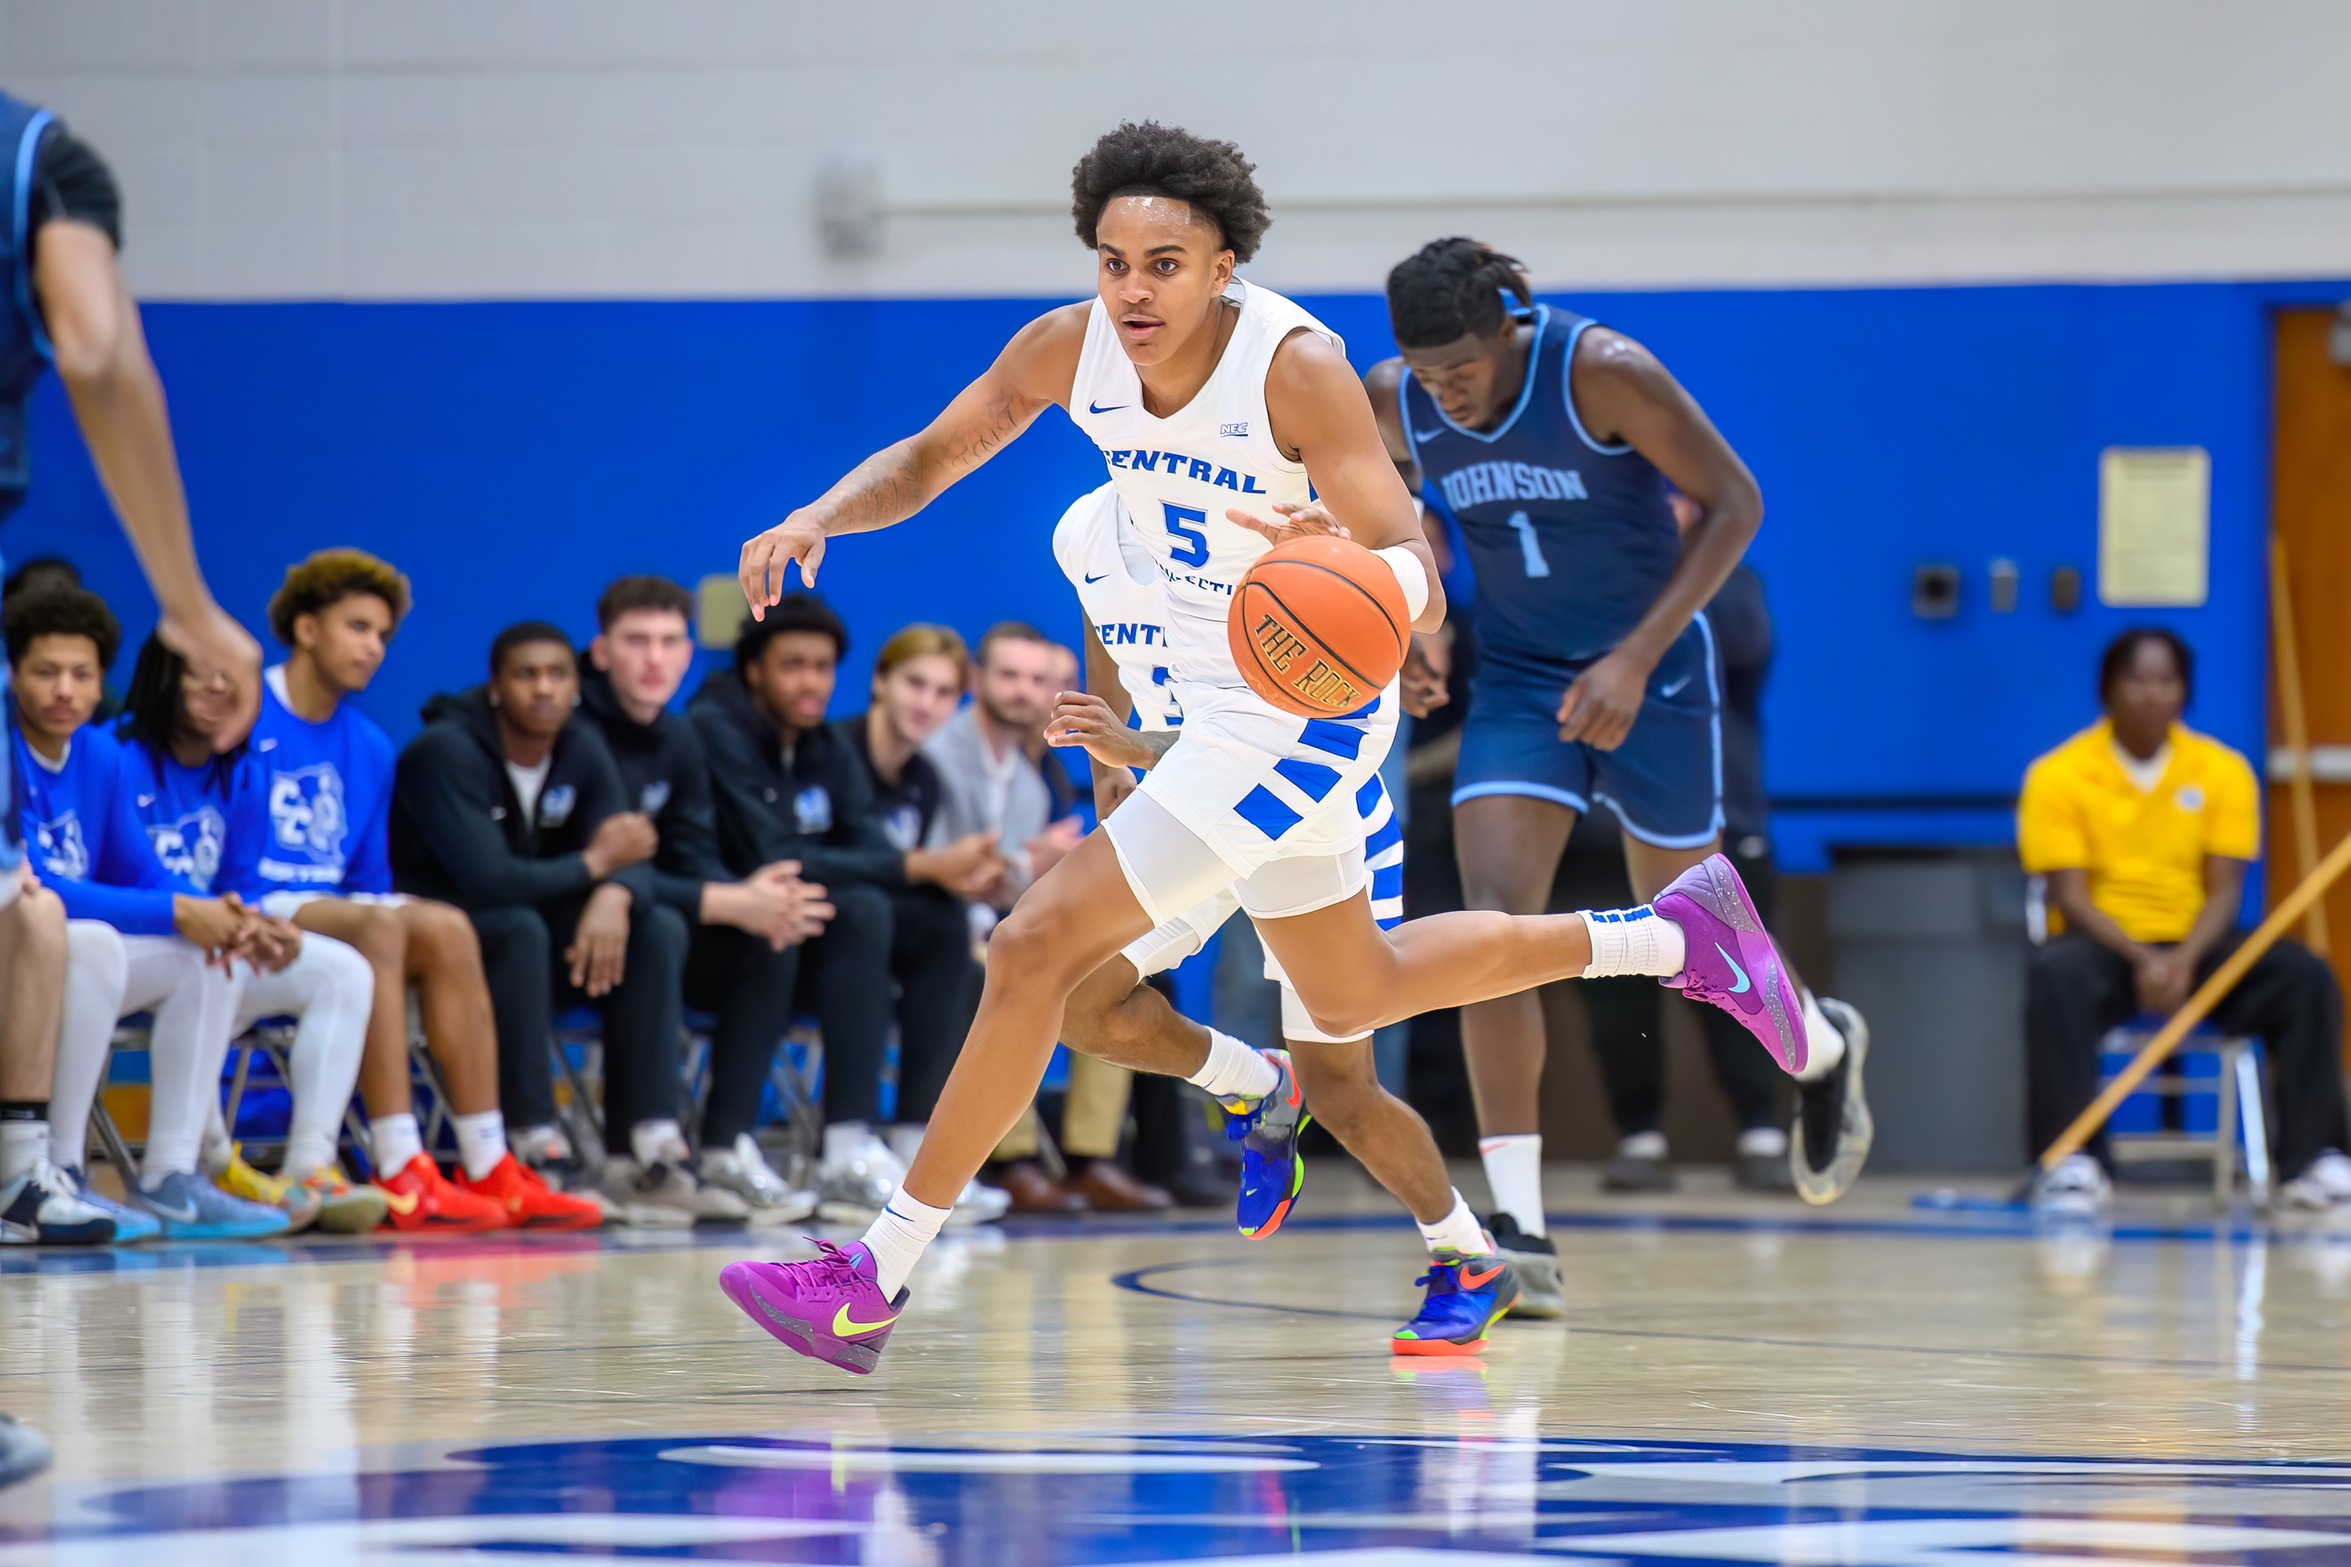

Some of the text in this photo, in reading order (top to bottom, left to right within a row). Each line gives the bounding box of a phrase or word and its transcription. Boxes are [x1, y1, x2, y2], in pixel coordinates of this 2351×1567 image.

[1219, 421, 1249, 436] NEC
[1440, 460, 1589, 511] JOHNSON
[1159, 500, 1211, 569] 5
[1507, 510, 1550, 578] 1
[1094, 622, 1168, 648] ENT
[1254, 613, 1309, 675] THE
[1291, 658, 1361, 709] ROCK
